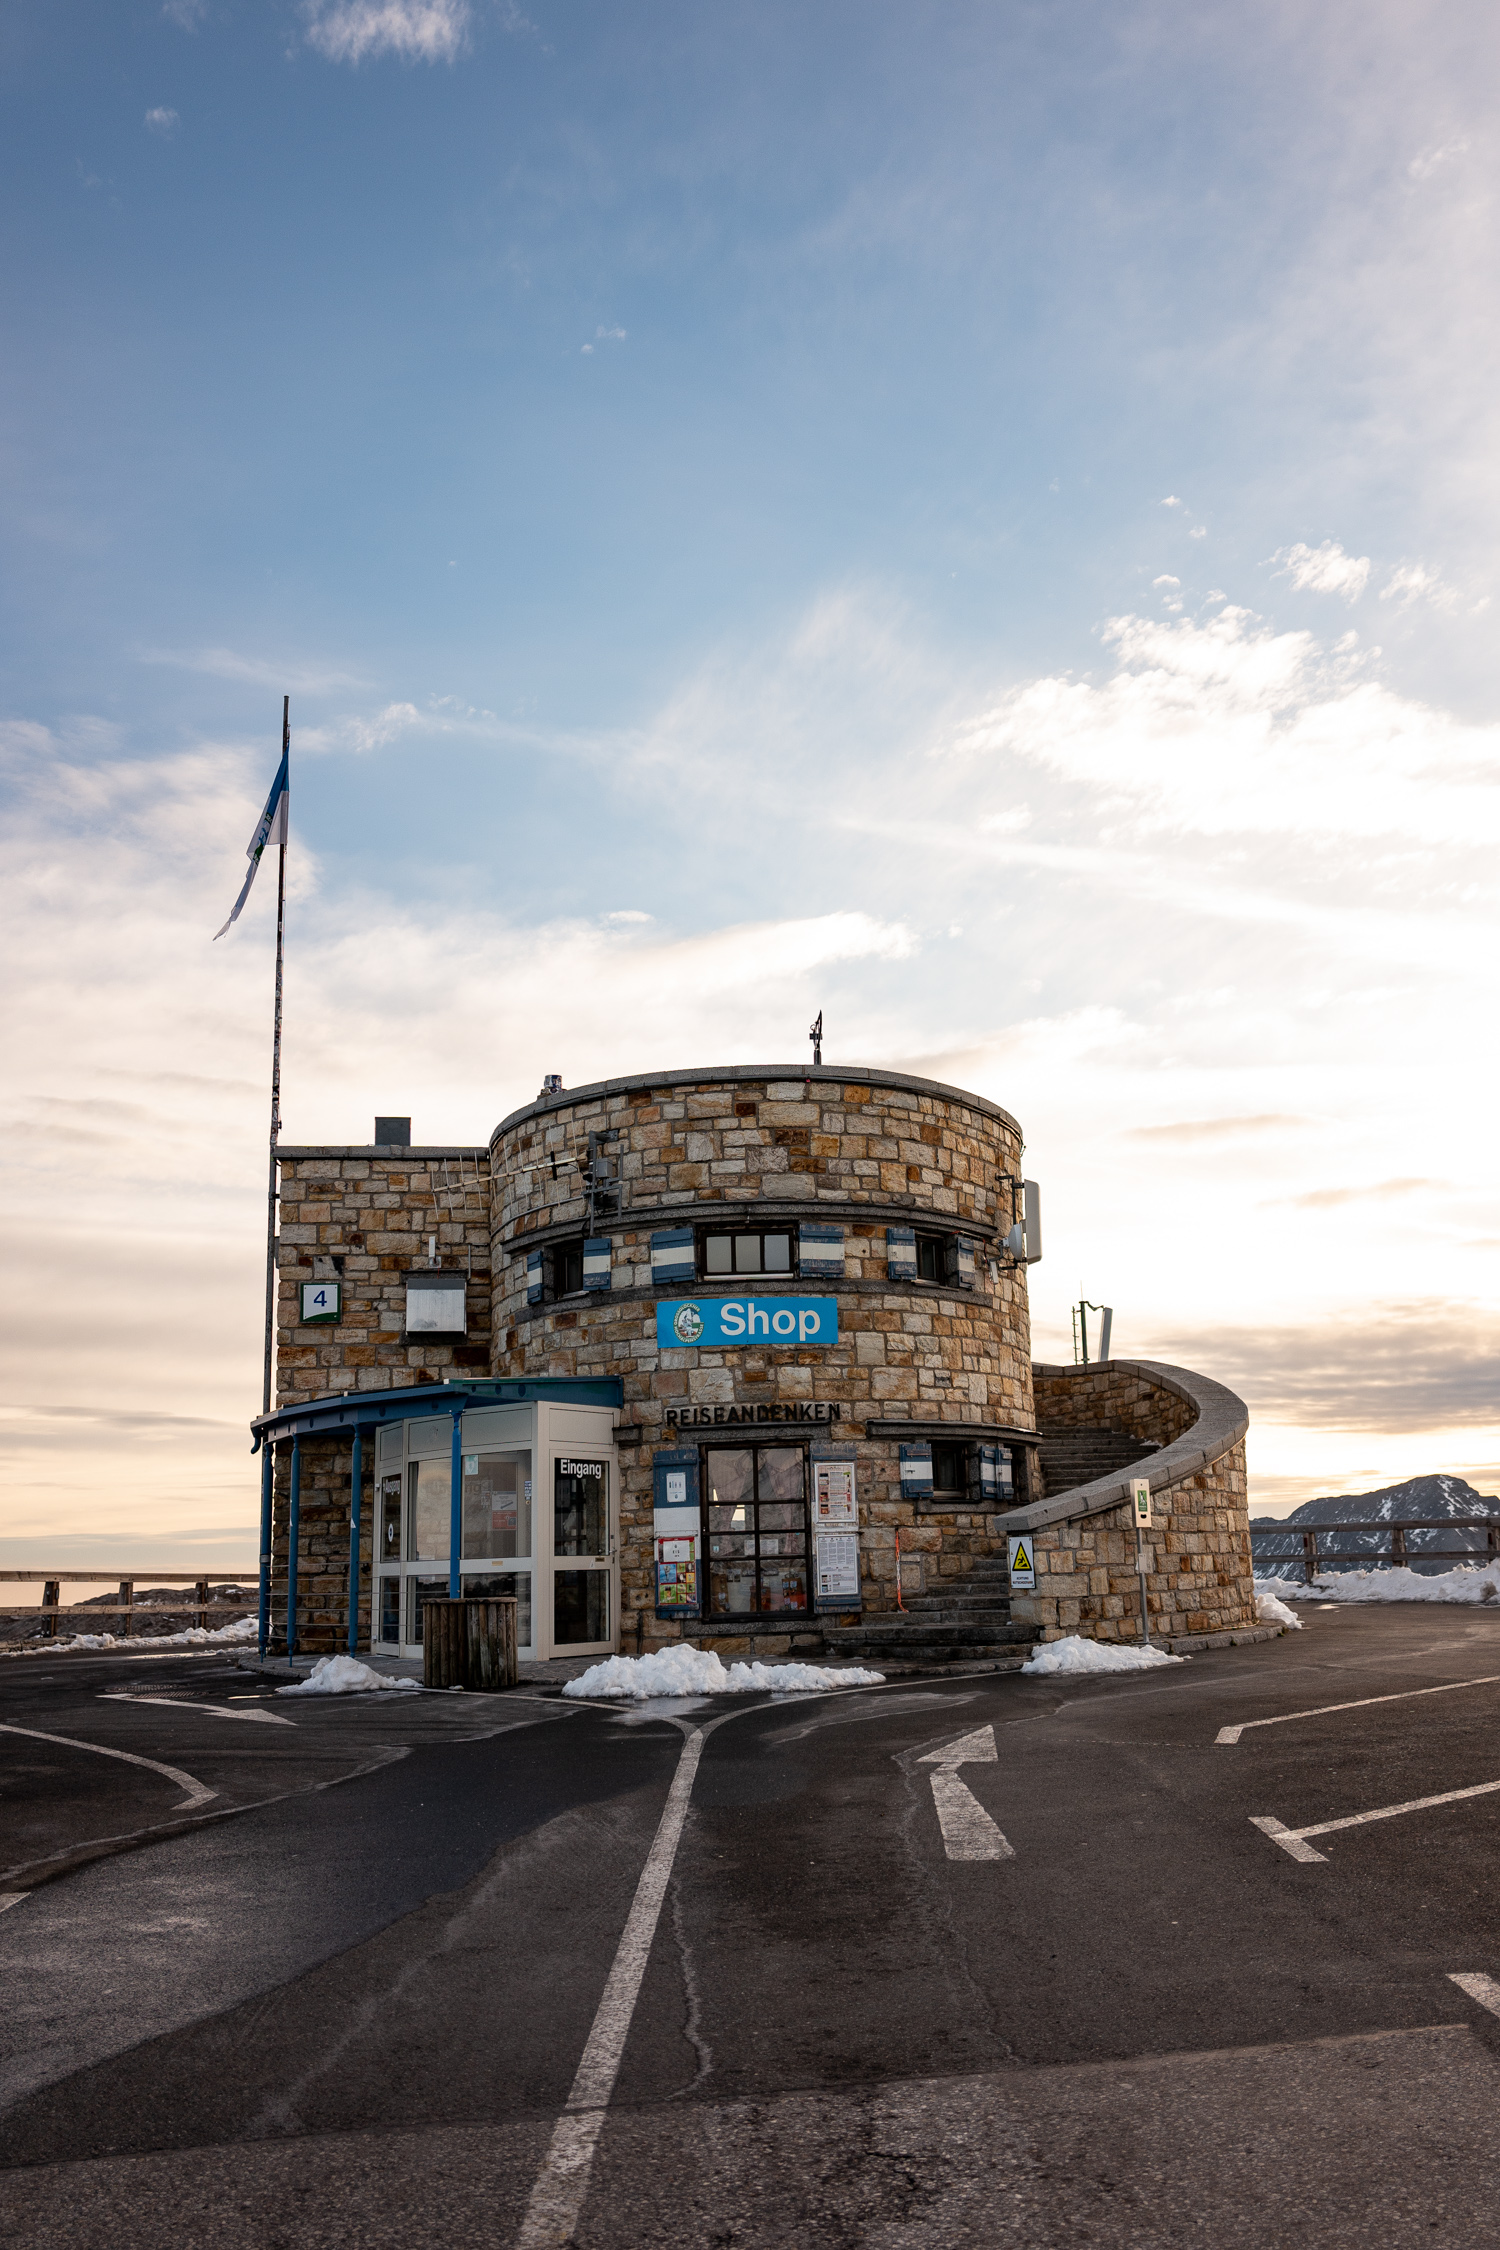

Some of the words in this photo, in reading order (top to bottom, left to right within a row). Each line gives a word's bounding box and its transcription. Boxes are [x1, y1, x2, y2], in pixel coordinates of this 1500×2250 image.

[313, 1290, 327, 1307] 4
[720, 1302, 821, 1342] Shop
[666, 1403, 841, 1428] REISEANDENKEN
[560, 1458, 602, 1479] Eingang
